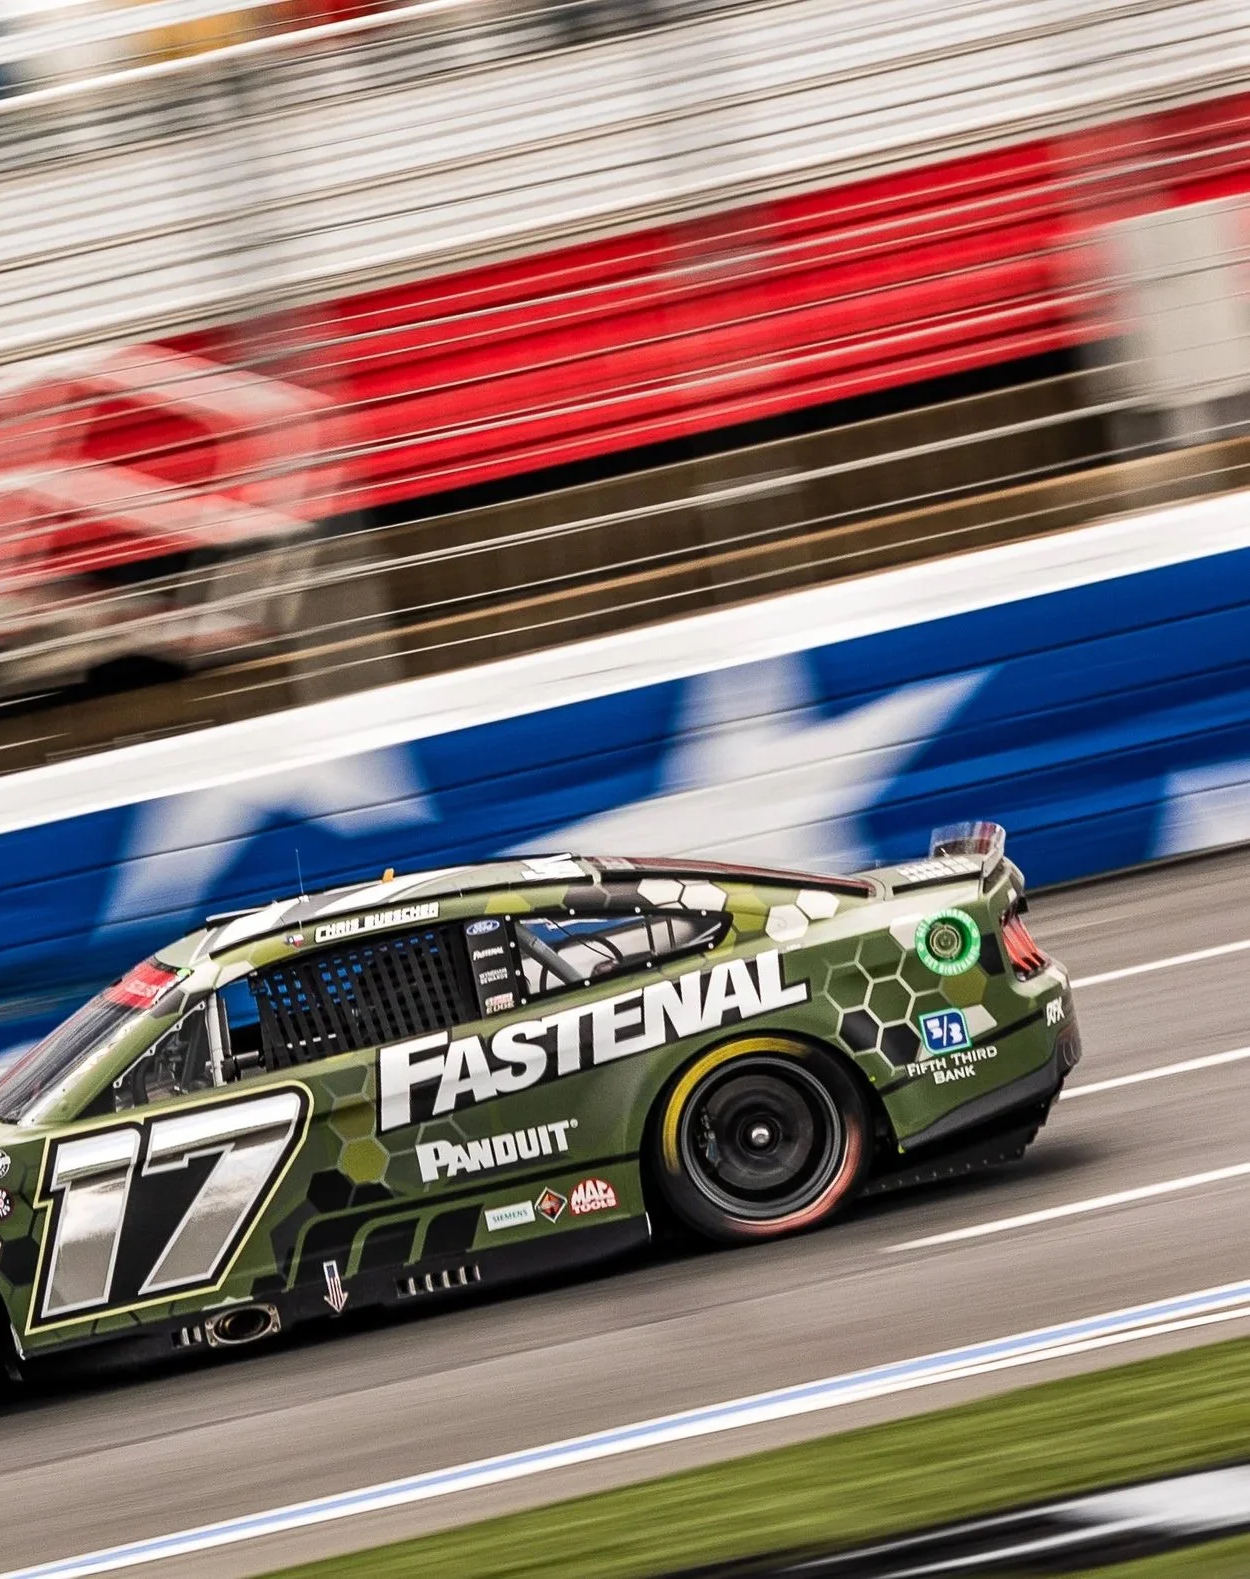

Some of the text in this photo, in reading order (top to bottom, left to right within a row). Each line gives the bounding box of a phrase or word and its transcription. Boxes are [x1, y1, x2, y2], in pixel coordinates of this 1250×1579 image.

[1046, 998, 1065, 1027] RFK
[380, 949, 808, 1132] FASTENAL
[906, 1046, 998, 1077] FIFTH THIRD
[933, 1065, 976, 1085] BANK
[40, 1091, 302, 1318] 17
[572, 1180, 616, 1205] MAC
[492, 1209, 528, 1223] SIEMENS
[573, 1199, 617, 1214] TOOLS
